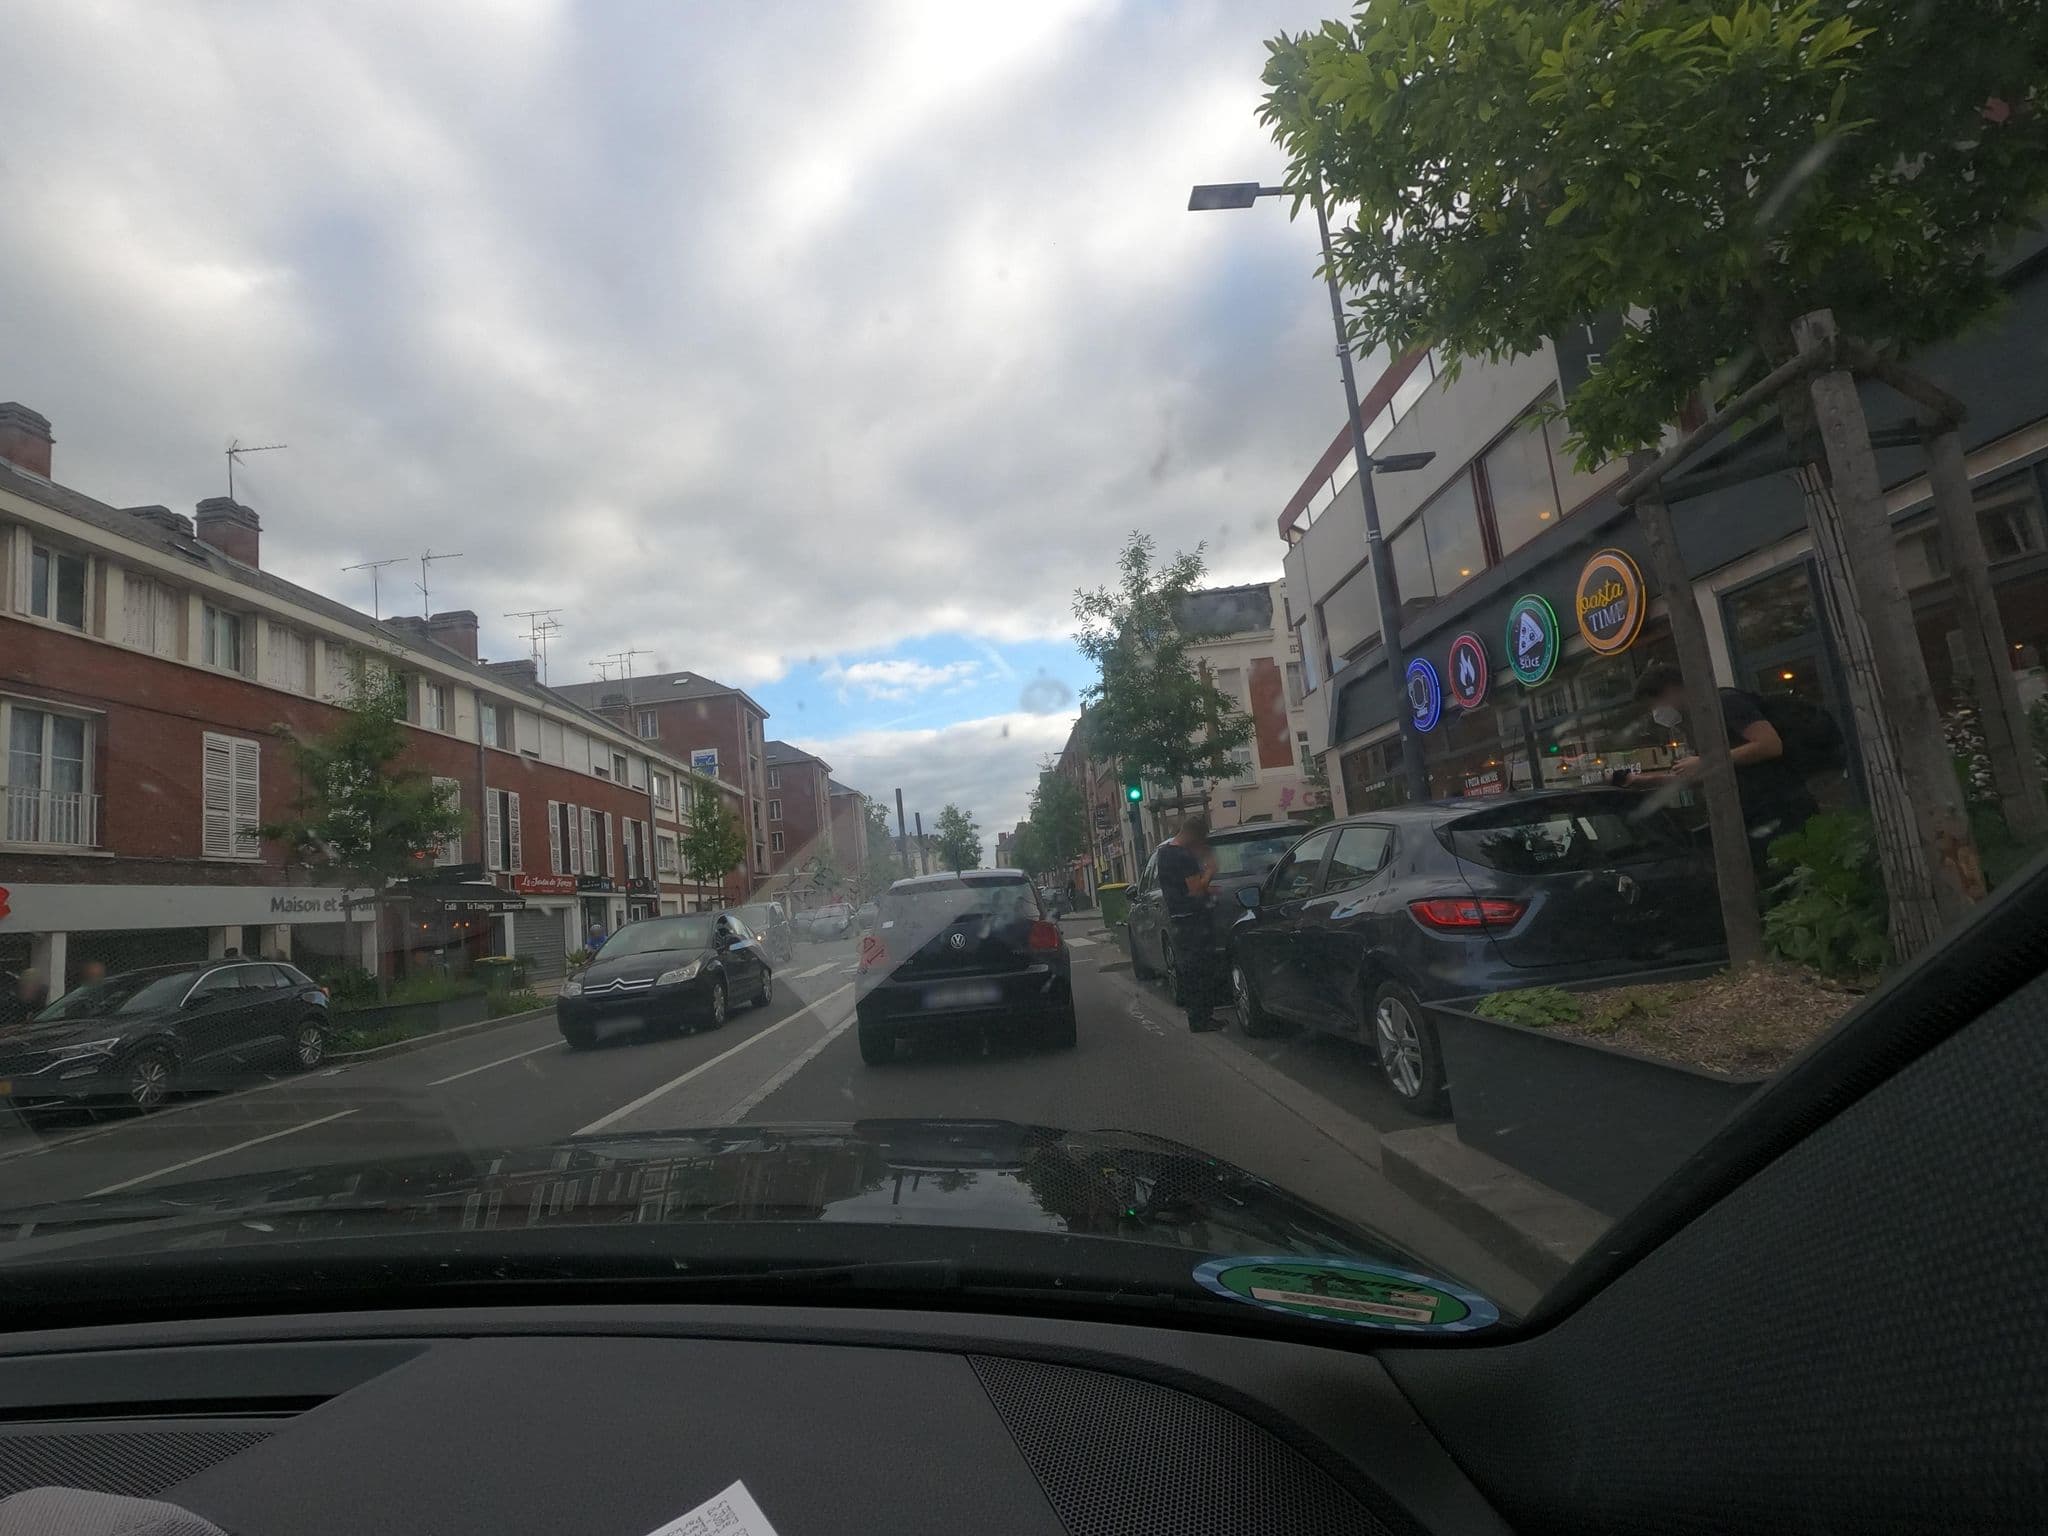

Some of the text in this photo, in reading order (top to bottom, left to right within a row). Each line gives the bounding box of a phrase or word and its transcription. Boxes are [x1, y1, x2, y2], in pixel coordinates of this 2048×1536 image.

[1578, 579, 1624, 614] pasta
[1588, 599, 1625, 632] TIME
[270, 896, 321, 913] Maison
[323, 897, 338, 912] et
